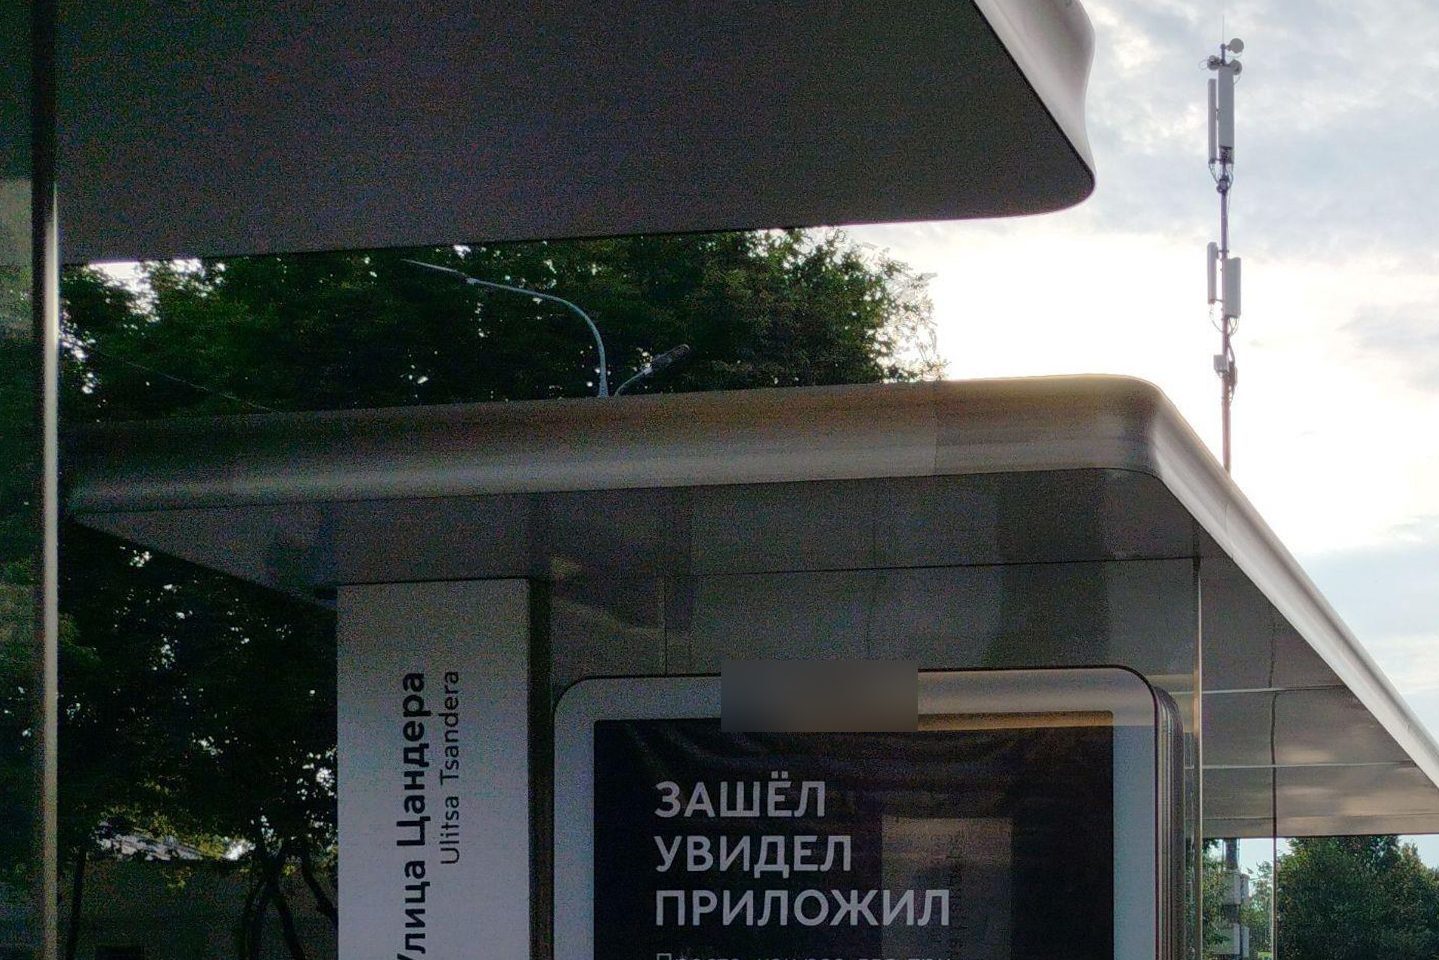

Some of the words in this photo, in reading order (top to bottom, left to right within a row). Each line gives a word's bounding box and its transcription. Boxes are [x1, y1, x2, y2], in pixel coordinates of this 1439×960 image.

[437, 670, 460, 786] Tsandera
[396, 671, 432, 847] Цандера
[654, 770, 826, 818] ЗАШЁЛ
[438, 795, 461, 866] Ulitsa
[653, 835, 852, 879] УВИДЕЛ
[655, 889, 950, 926] ПРИЛОЖИЛ
